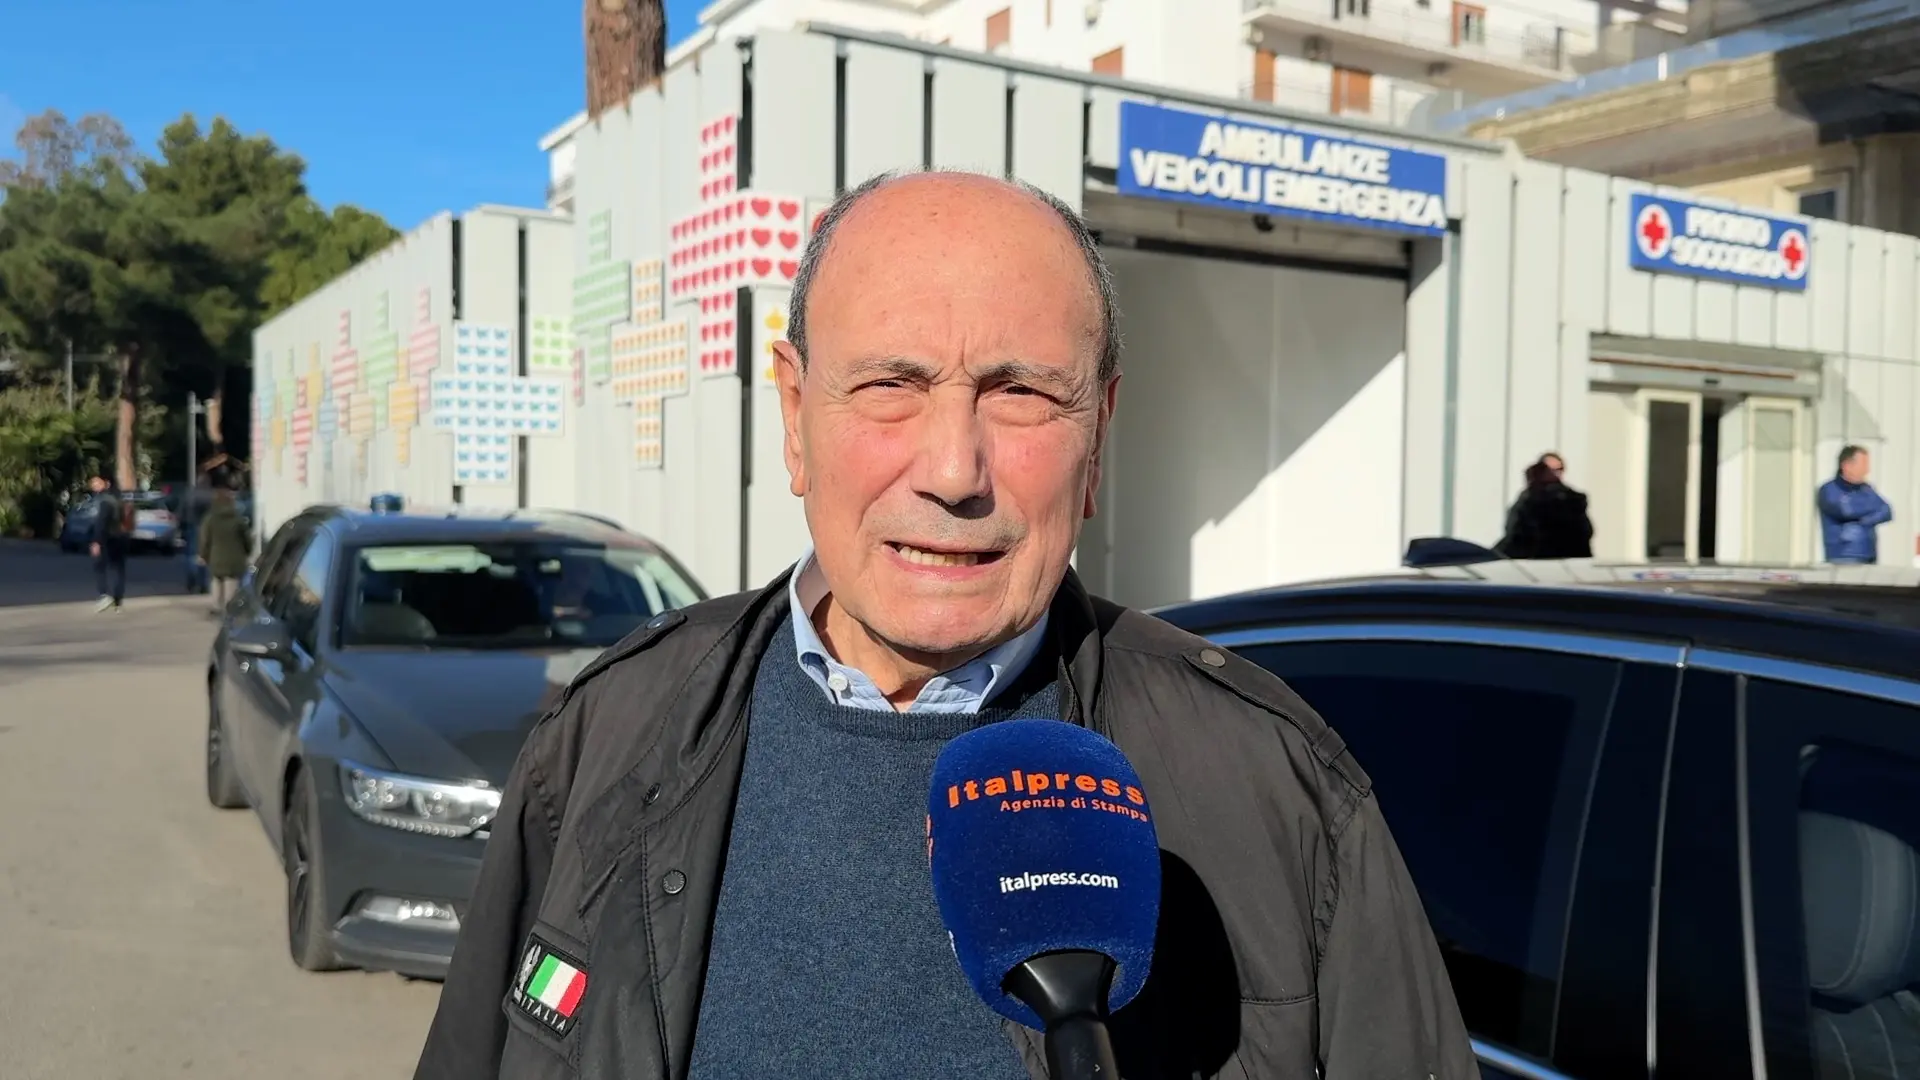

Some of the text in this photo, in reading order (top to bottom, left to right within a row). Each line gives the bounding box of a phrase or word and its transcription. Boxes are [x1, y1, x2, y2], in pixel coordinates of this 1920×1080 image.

[1199, 121, 1390, 184] AMBULANZE
[1130, 149, 1447, 229] VEICOLI EMERGENZA
[948, 769, 1145, 808] Italpress
[1000, 796, 1148, 822] Agenzia di Stampa
[1000, 871, 1119, 893] italpress.com
[520, 995, 567, 1031] ITALIA
